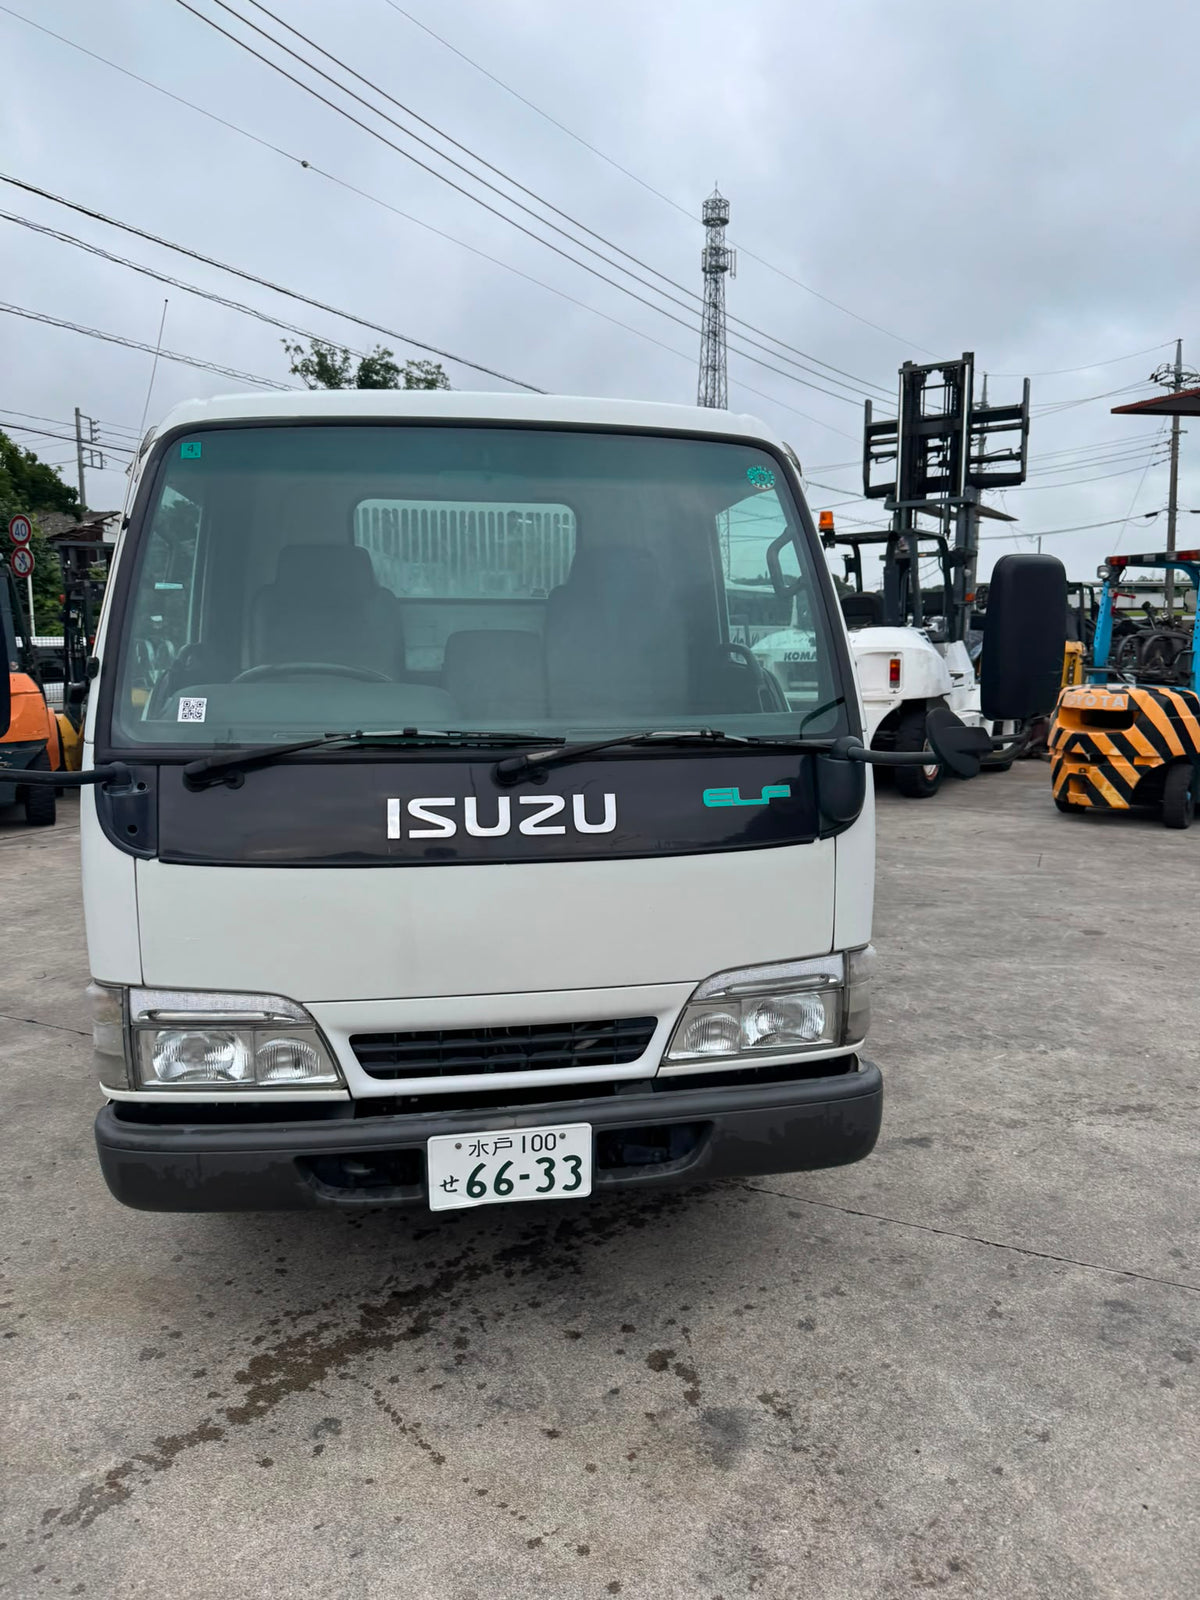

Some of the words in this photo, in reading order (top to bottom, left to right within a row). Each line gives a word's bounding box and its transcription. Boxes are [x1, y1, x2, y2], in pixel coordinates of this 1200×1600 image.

[14, 523, 27, 537] 40
[1064, 694, 1125, 708] OYOTA
[703, 785, 791, 807] ELF
[387, 793, 616, 839] ISUZU
[468, 1137, 513, 1157] 水戸
[522, 1133, 557, 1153] 100
[440, 1175, 460, 1193] せ
[466, 1155, 582, 1199] 66-33
